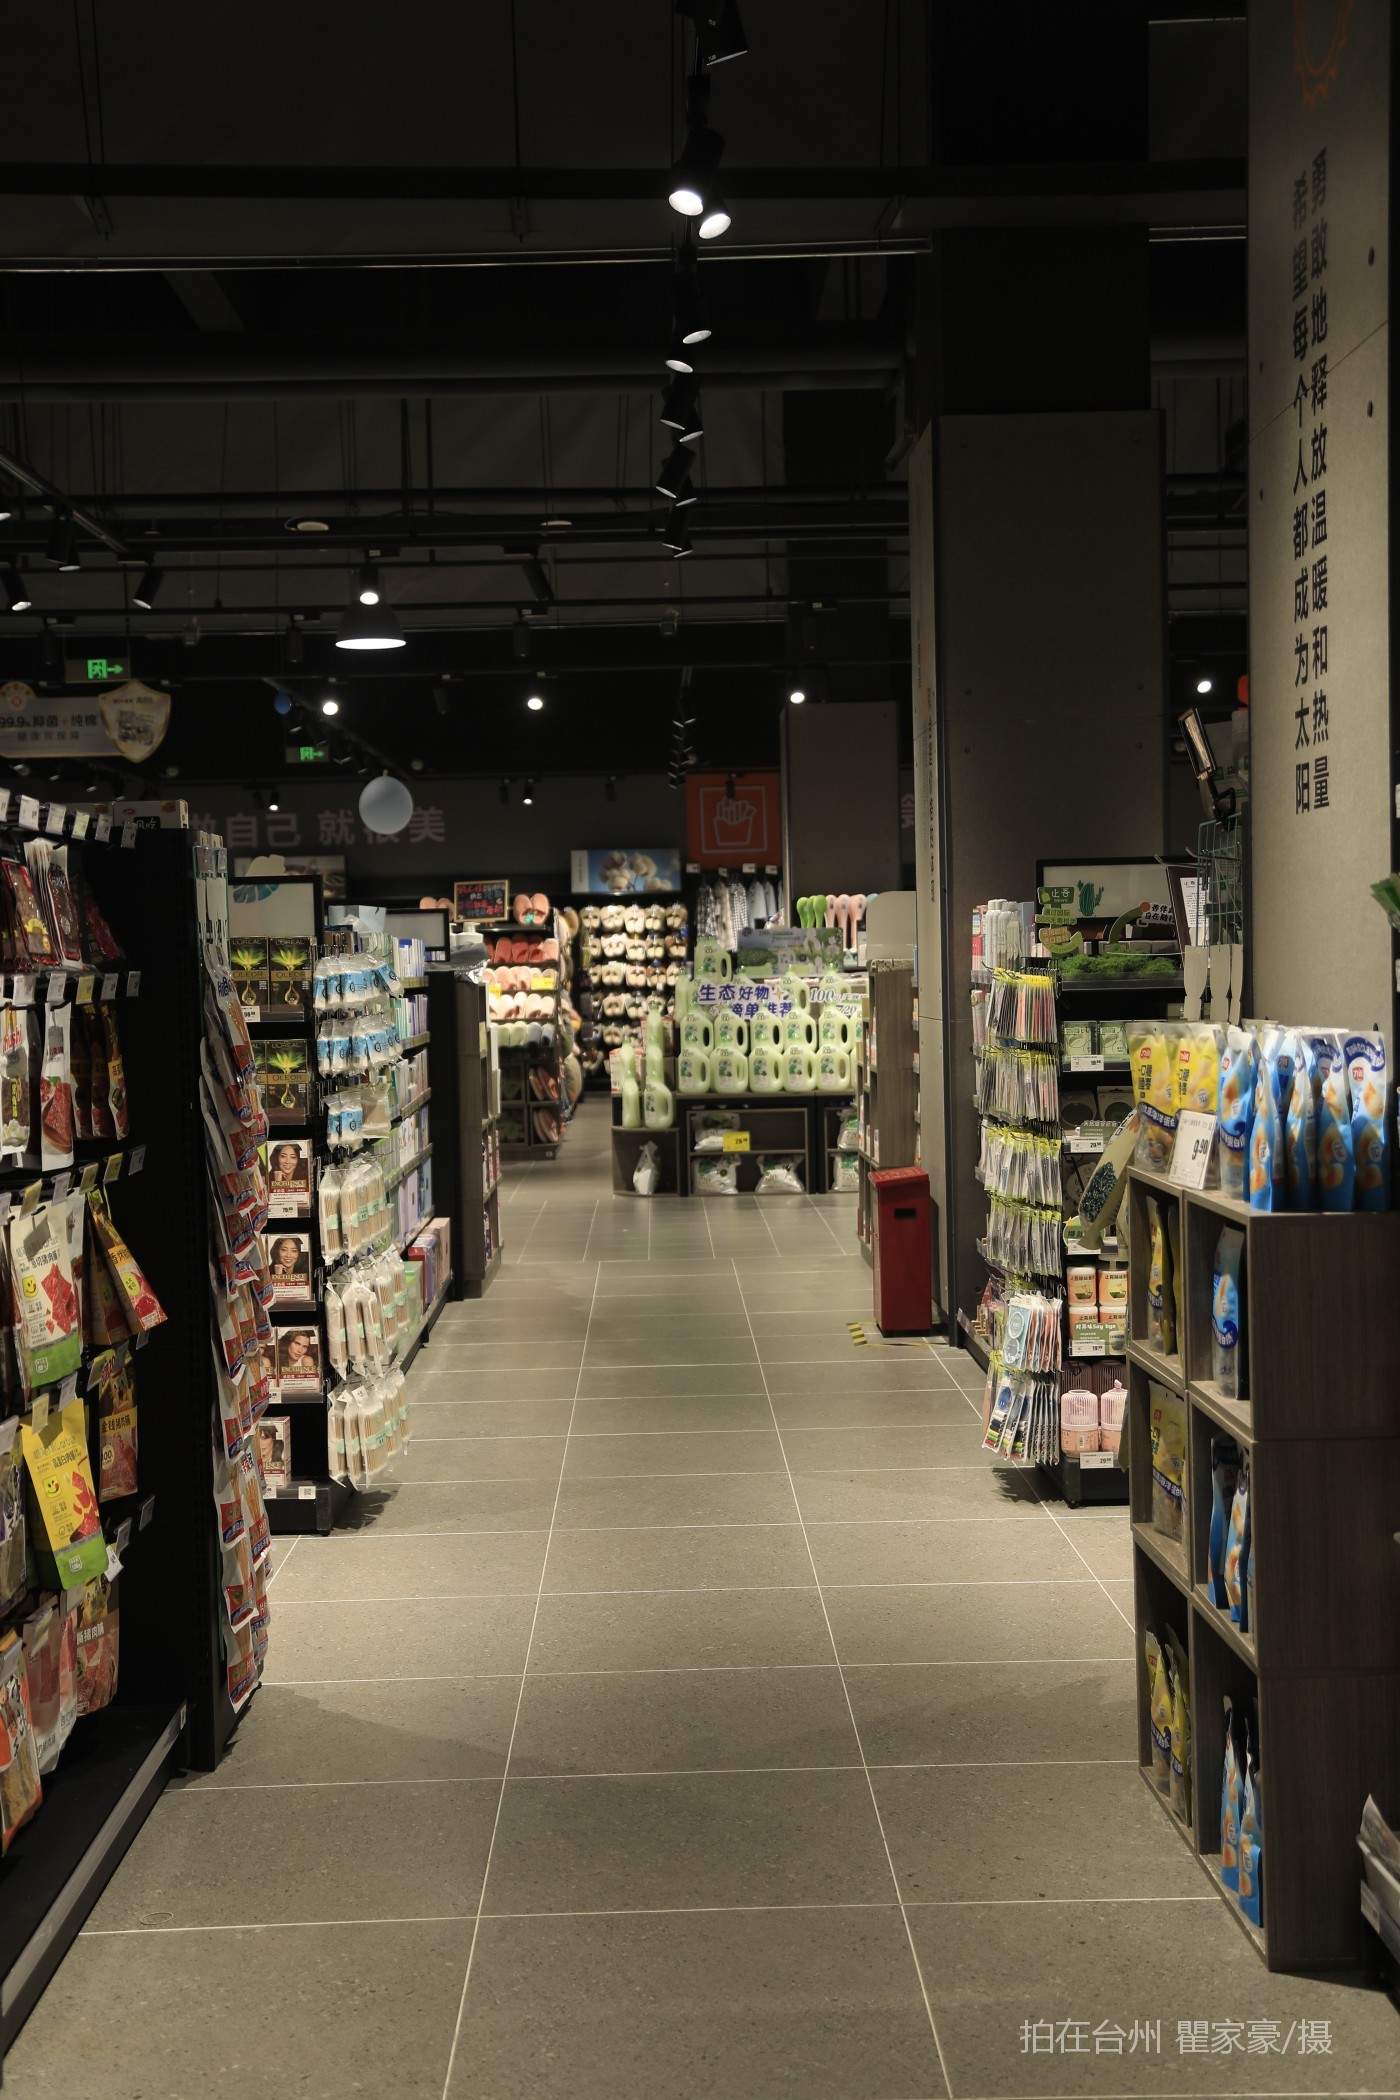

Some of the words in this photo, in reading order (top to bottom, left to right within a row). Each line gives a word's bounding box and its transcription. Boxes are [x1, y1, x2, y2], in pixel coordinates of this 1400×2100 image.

[1291, 168, 1310, 815] 希望每个人都成为太阳
[1310, 146, 1330, 810] 勇敢地释放温暖和热量
[698, 984, 770, 1002] 生态好物
